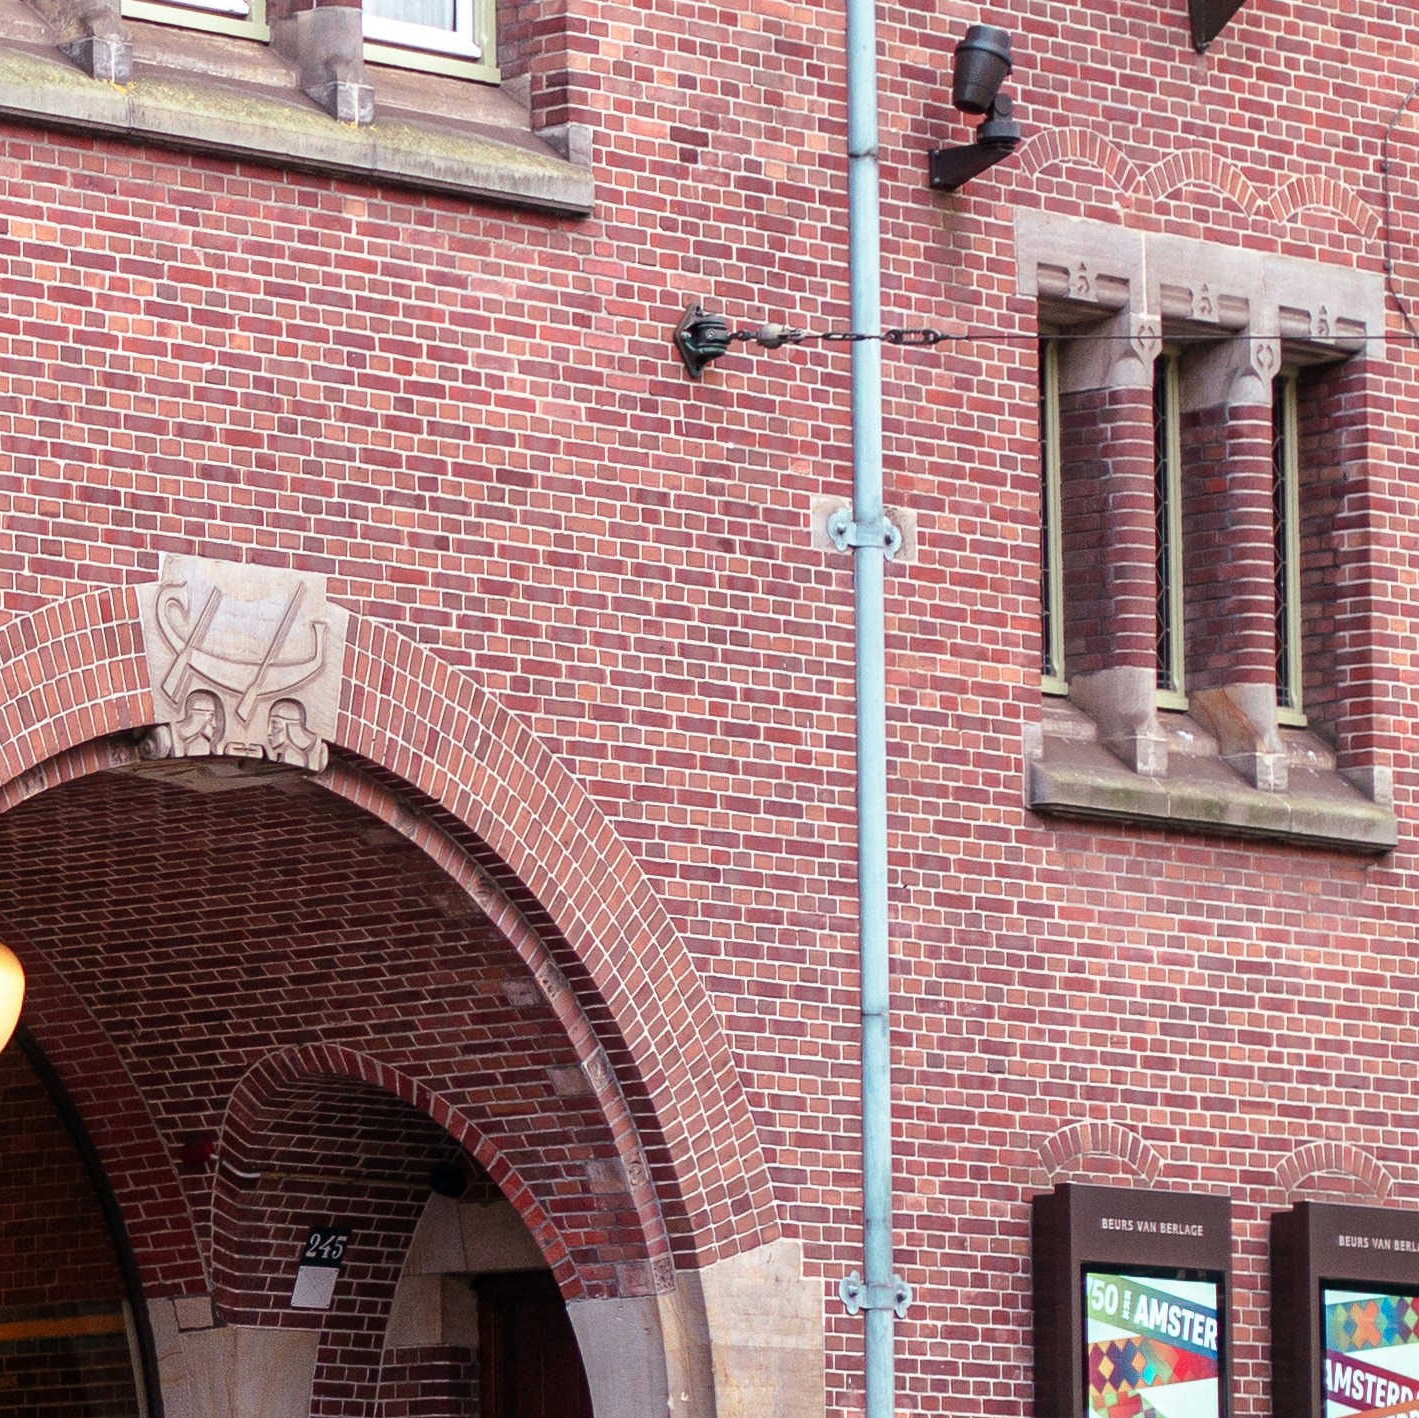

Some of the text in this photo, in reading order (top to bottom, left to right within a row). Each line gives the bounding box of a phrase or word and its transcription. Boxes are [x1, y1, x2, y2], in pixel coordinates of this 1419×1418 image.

[1101, 1218, 1204, 1236] BEURS VAN BERLAGE
[305, 1233, 347, 1259] 245
[1338, 1235, 1369, 1248] BEURS
[1372, 1238, 1391, 1250] VAN
[1133, 1294, 1217, 1348] AMSTER
[1326, 1359, 1419, 1408] MSTERD
